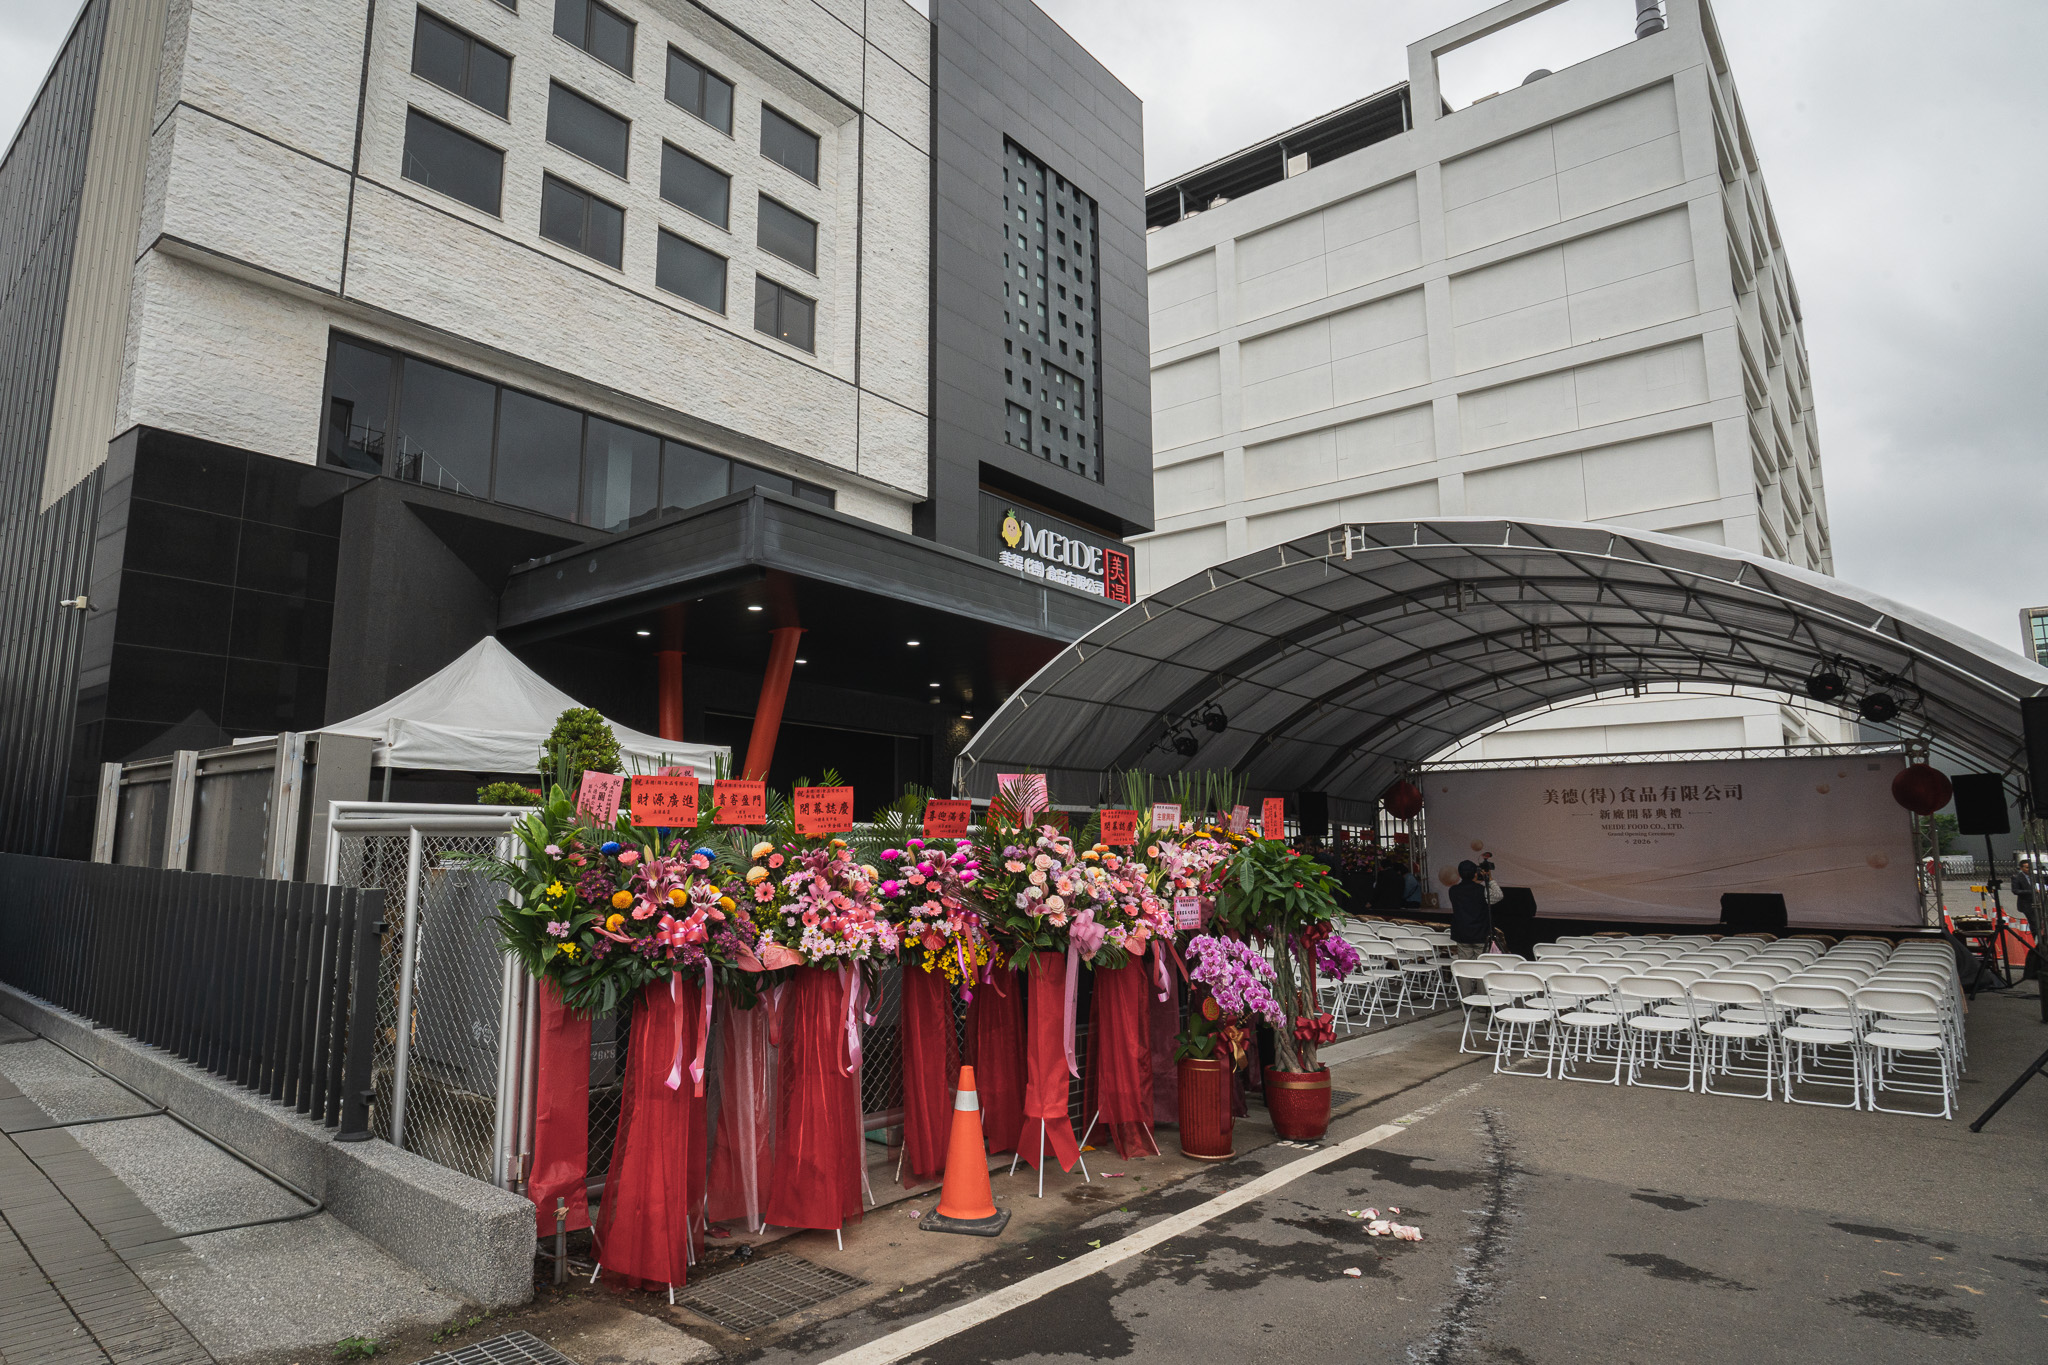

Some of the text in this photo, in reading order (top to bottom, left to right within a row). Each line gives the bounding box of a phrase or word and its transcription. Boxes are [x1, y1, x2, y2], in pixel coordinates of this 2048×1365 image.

[637, 792, 694, 808] 財源廣進
[718, 793, 761, 807] 貴客盈門
[1543, 784, 1743, 805] 美德(得)食品有限公司
[799, 801, 849, 816] 開幕誌慶
[1599, 808, 1682, 820] 新廠開幕典禮
